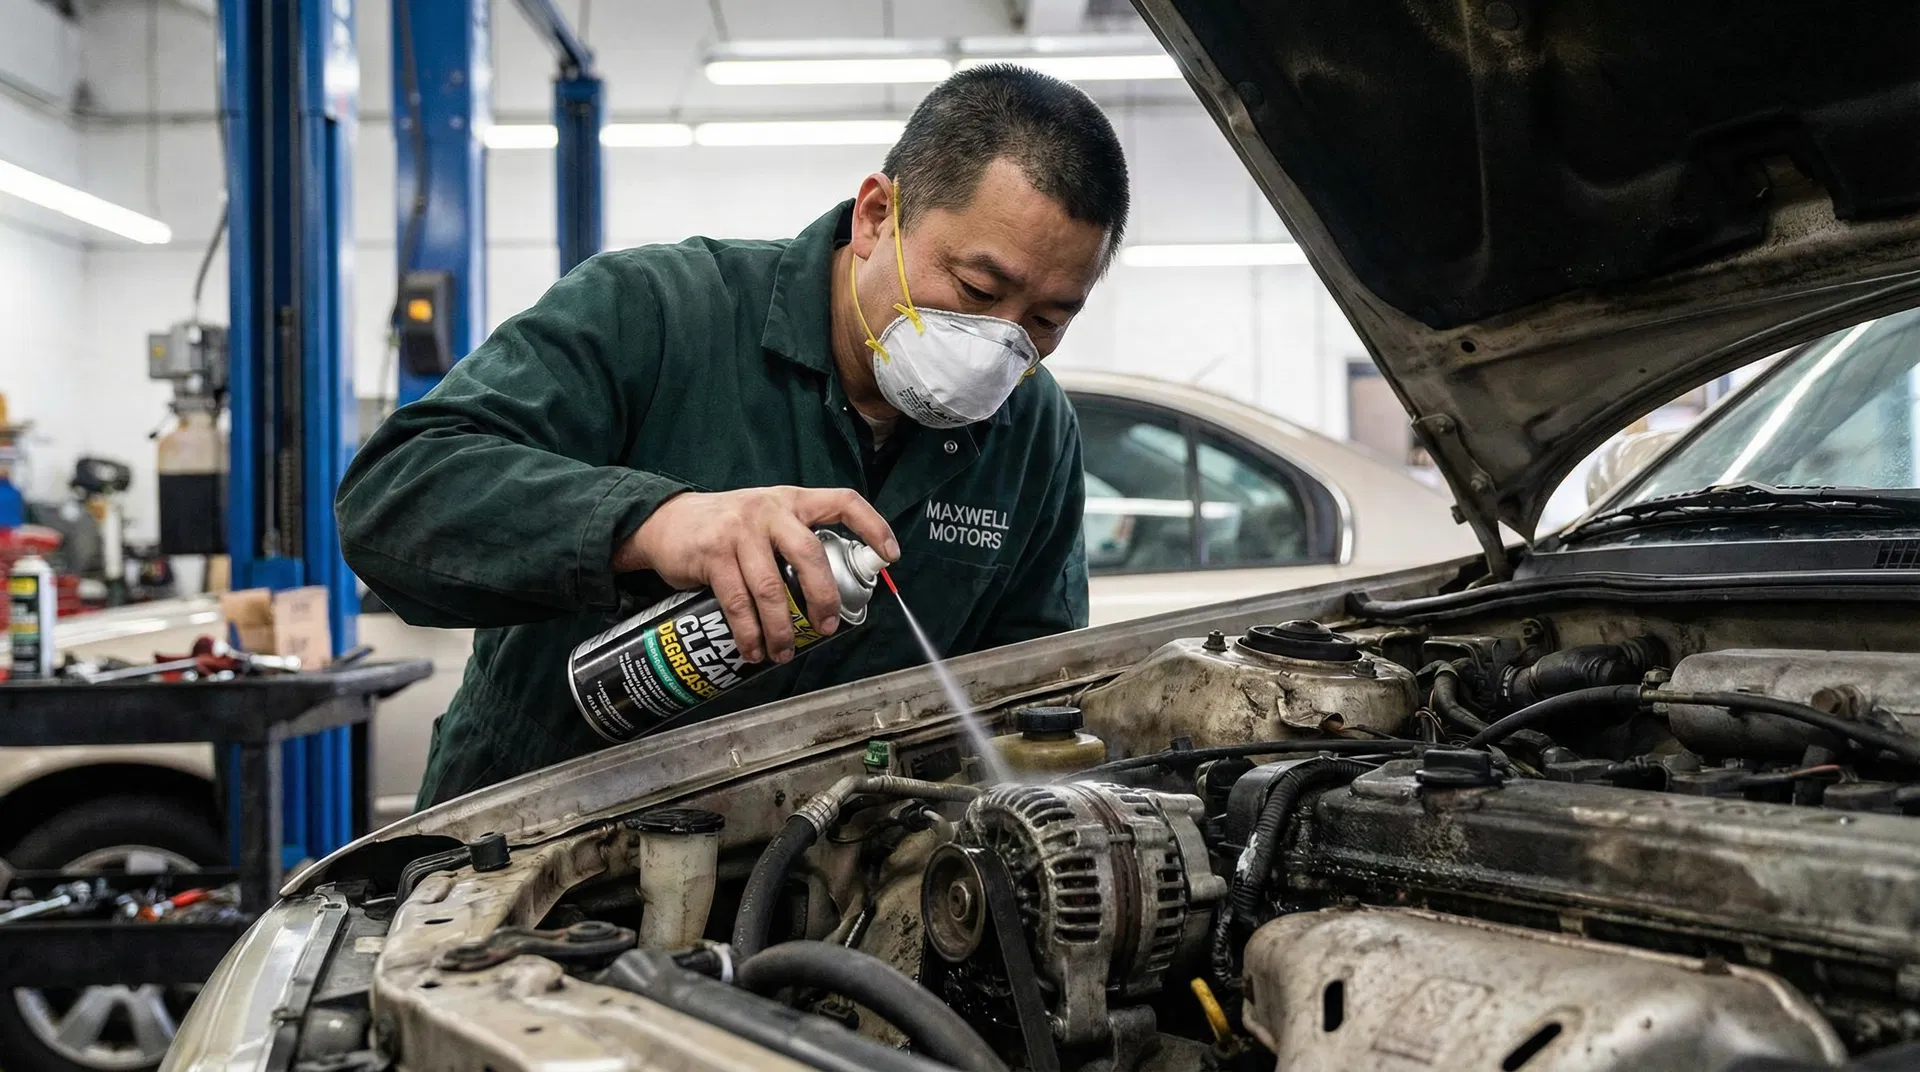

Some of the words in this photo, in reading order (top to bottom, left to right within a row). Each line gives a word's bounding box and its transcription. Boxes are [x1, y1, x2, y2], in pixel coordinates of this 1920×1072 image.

[926, 499, 1010, 530] MAXWELL
[929, 521, 1002, 550] MOTORS
[675, 614, 742, 689] CLEAN
[699, 610, 745, 672] MAX
